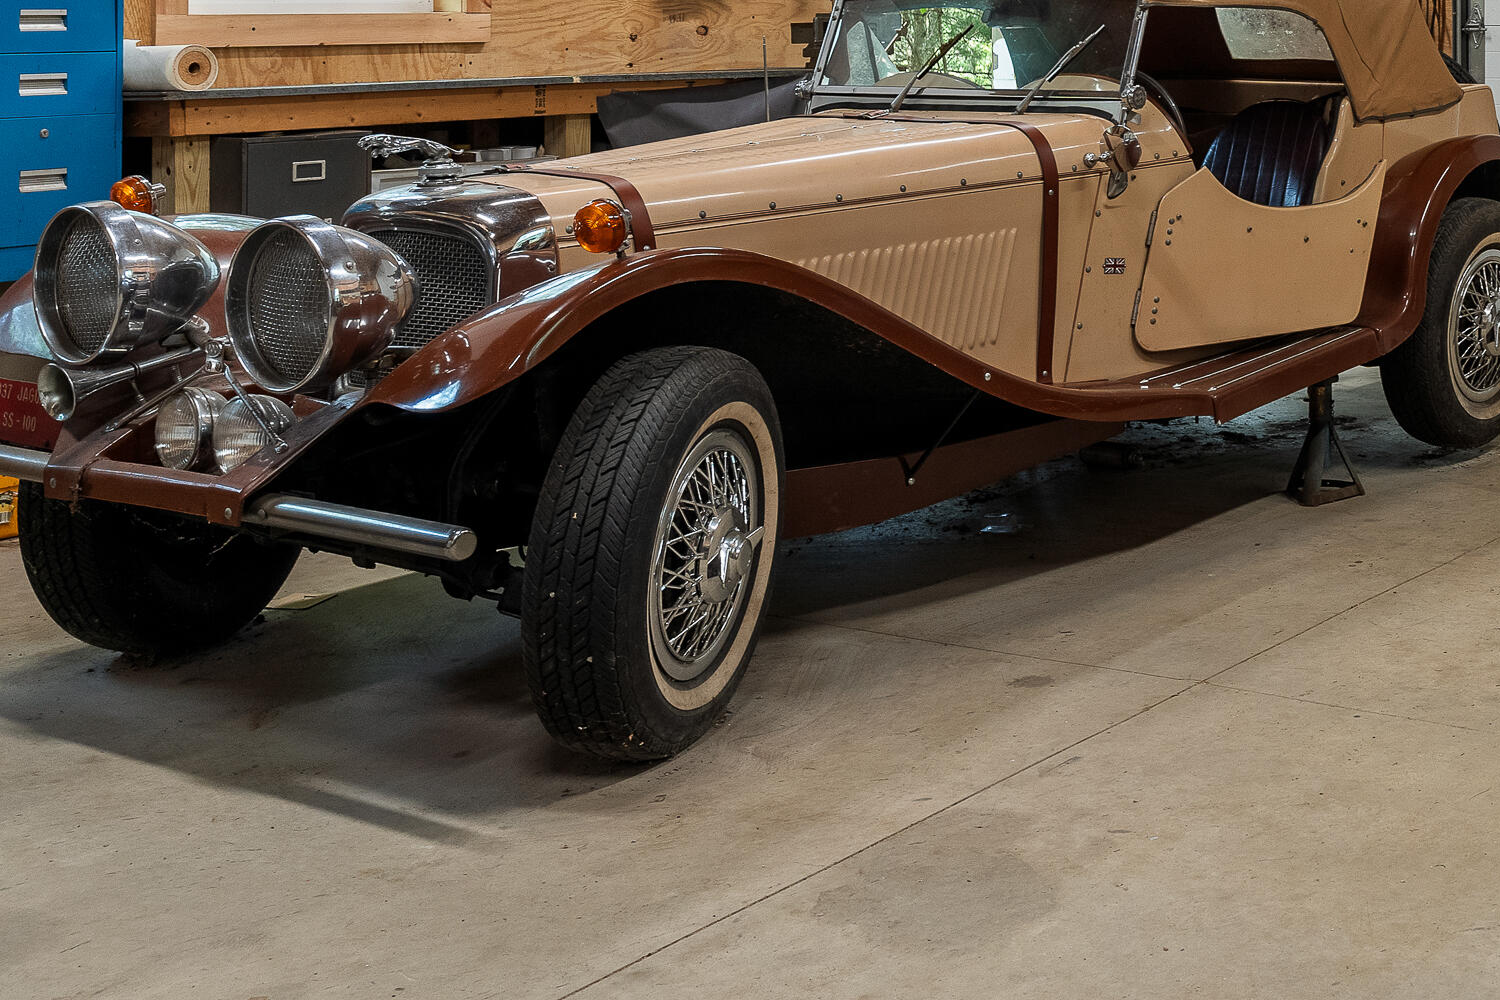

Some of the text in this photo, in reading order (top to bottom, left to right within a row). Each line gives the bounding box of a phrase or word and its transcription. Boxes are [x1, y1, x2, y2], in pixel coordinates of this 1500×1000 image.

[0, 383, 40, 404] 37 JAGU
[2, 411, 14, 428] SS
[22, 414, 37, 432] 100
